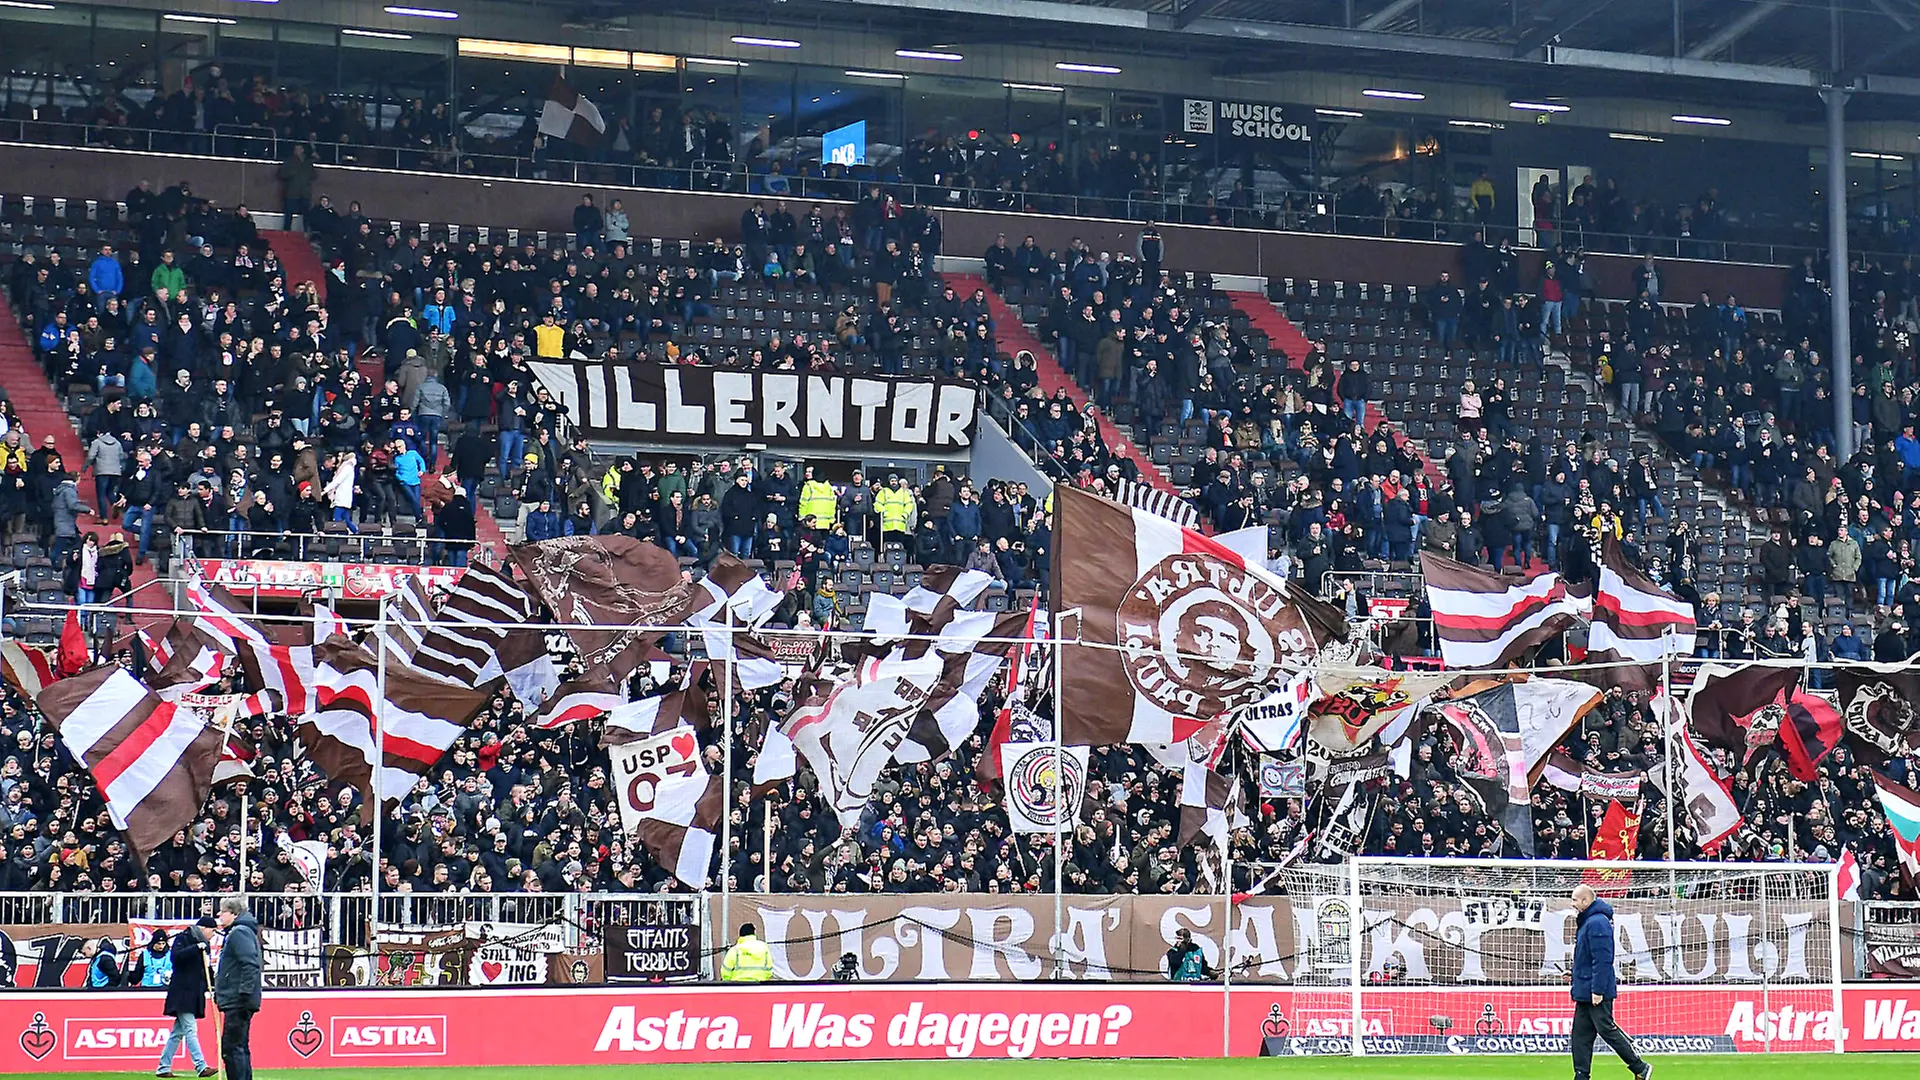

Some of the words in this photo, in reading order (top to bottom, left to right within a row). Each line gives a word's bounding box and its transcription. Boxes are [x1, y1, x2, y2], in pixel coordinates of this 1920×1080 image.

[1221, 103, 1283, 122] MUSIC
[1232, 120, 1311, 141] SCHOOL
[1244, 702, 1293, 721] ULTRAS
[622, 744, 671, 775] USP
[263, 929, 319, 950] YALLA
[626, 927, 690, 949] ENFANTS
[756, 906, 1123, 982] ULTRA'
[1158, 903, 1489, 982] SAKT
[480, 948, 512, 961] STILL
[515, 950, 538, 962] NOT
[624, 950, 690, 973] TERRIBLES
[504, 963, 538, 983] 'ING
[74, 1028, 173, 1049] ASTRA
[340, 1026, 437, 1047] ASTRA
[593, 1005, 752, 1052] Astra.
[769, 1003, 876, 1049] Was
[887, 1001, 1133, 1058] dagegen?
[1317, 1035, 1405, 1053] constar
[1476, 1035, 1570, 1053] congstar
